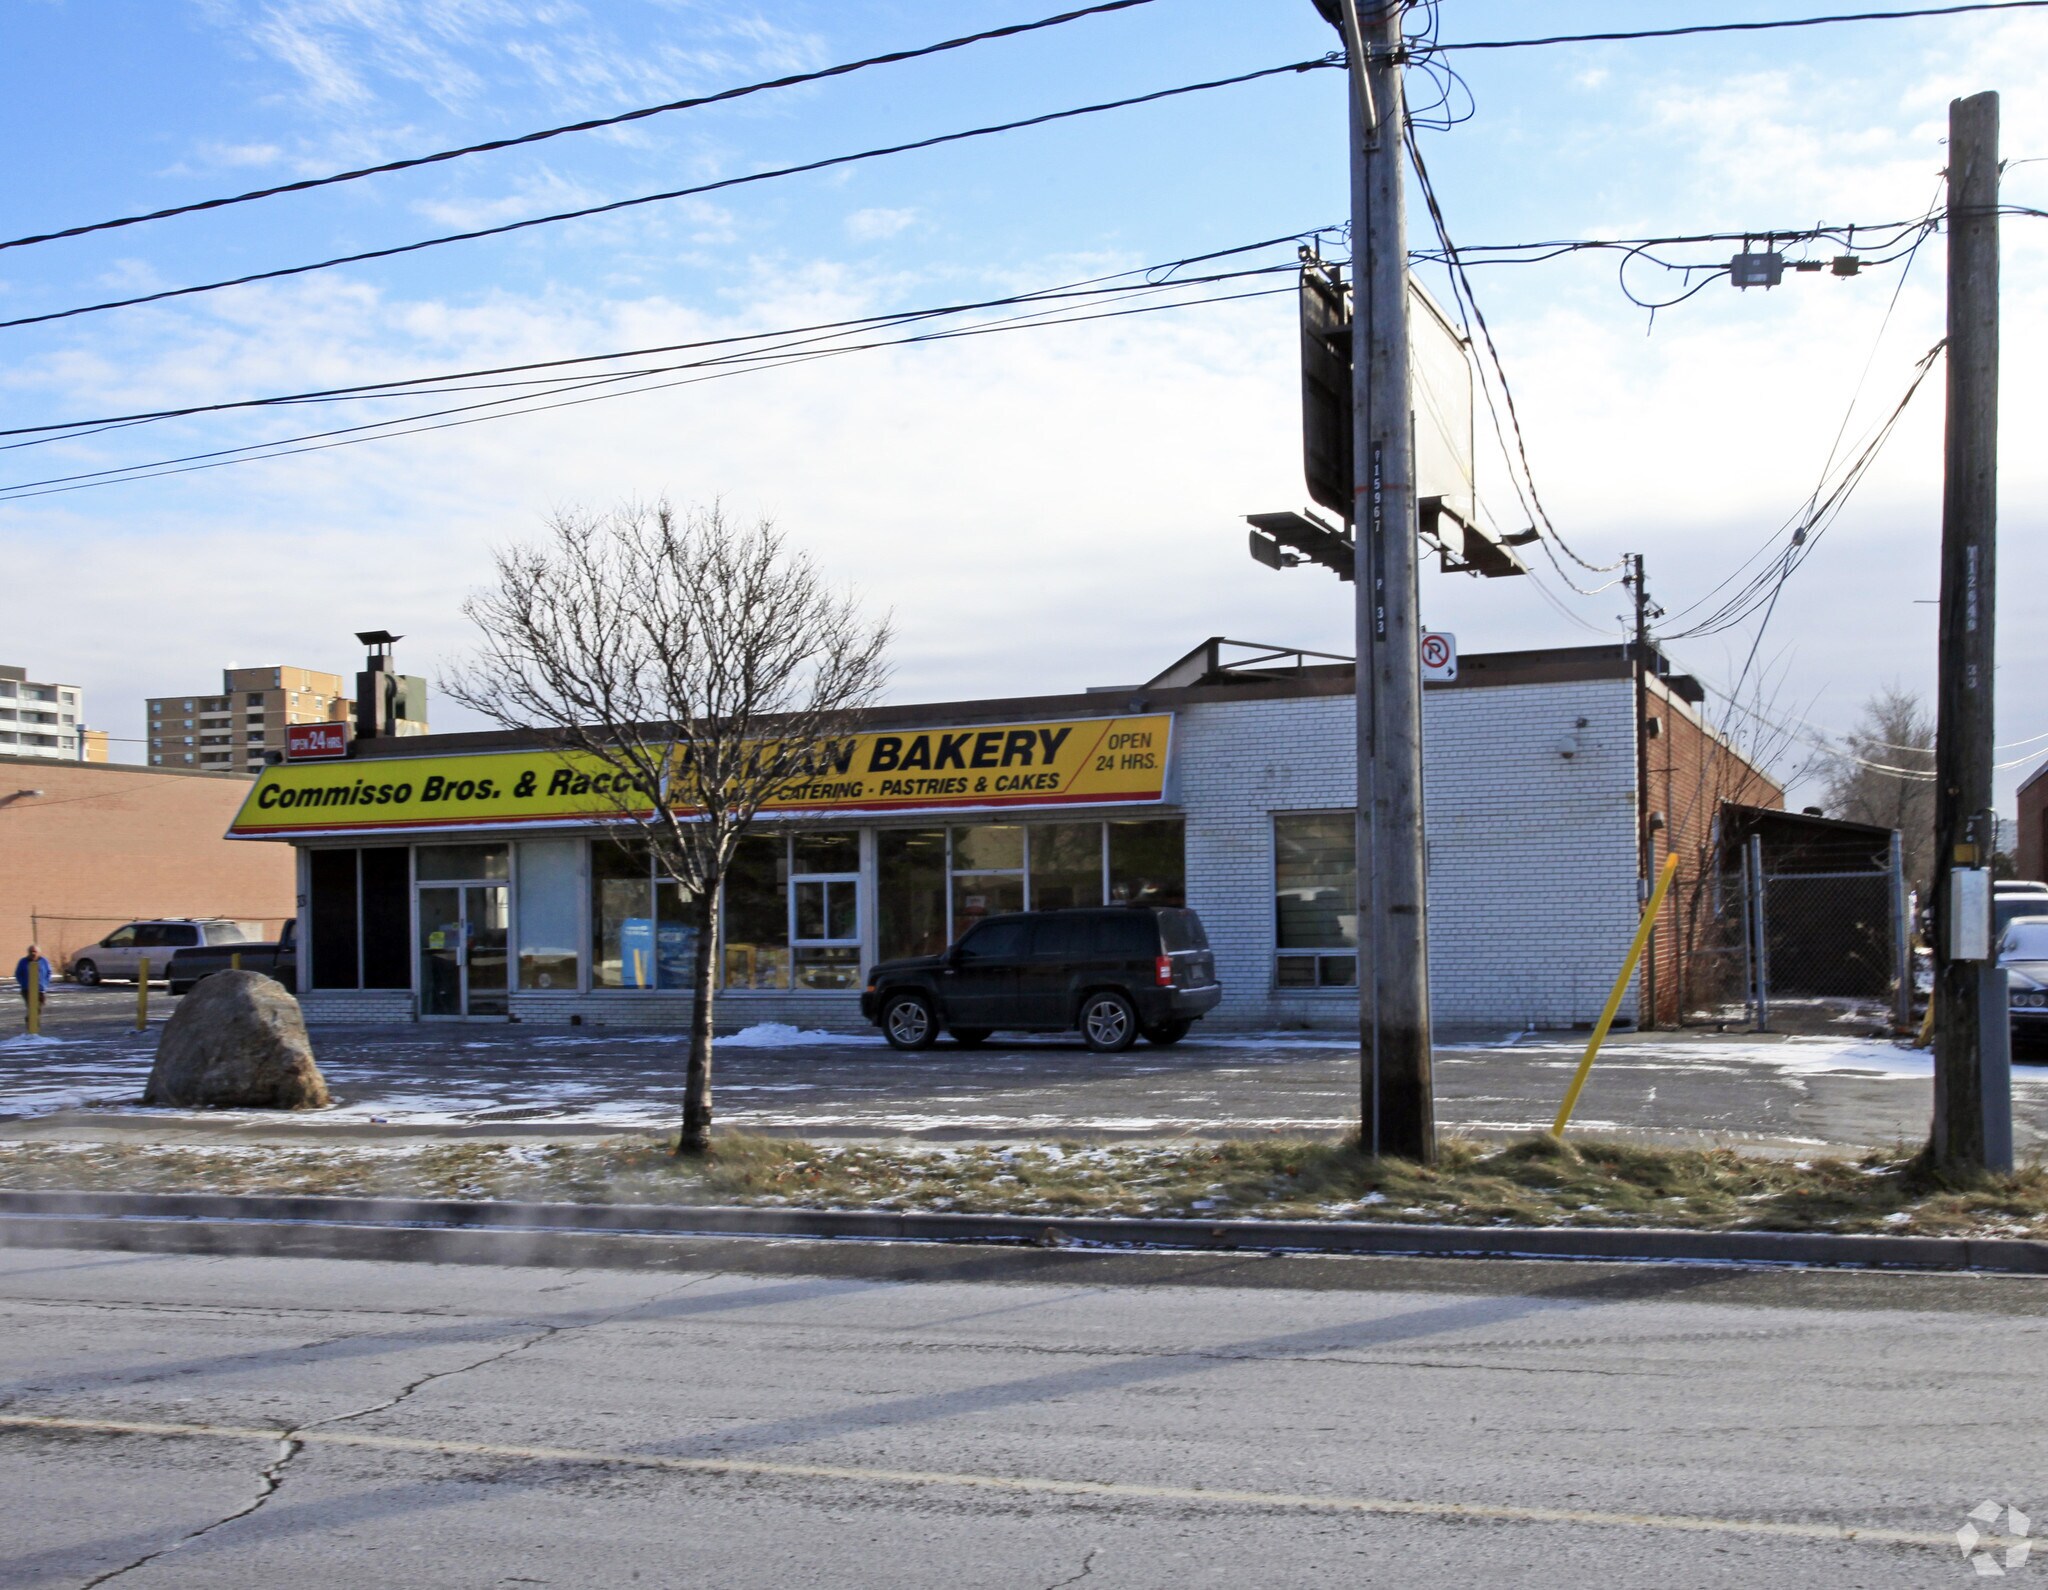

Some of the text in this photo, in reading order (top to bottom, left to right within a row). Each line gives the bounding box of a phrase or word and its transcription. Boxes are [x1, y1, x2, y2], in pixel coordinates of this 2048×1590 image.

[290, 738, 309, 751] OPEN
[309, 730, 326, 750] 24
[1108, 732, 1152, 750] OPEN
[679, 727, 1074, 780] ILIAN BAKERY
[1095, 752, 1159, 772] 24 HRS.
[258, 779, 413, 809] Commisso
[420, 775, 501, 802] Bros.
[513, 770, 538, 798] &
[778, 781, 864, 801] CATERING
[880, 777, 968, 796] PASTRIES
[974, 776, 988, 793] &
[994, 772, 1061, 791] CAKES
